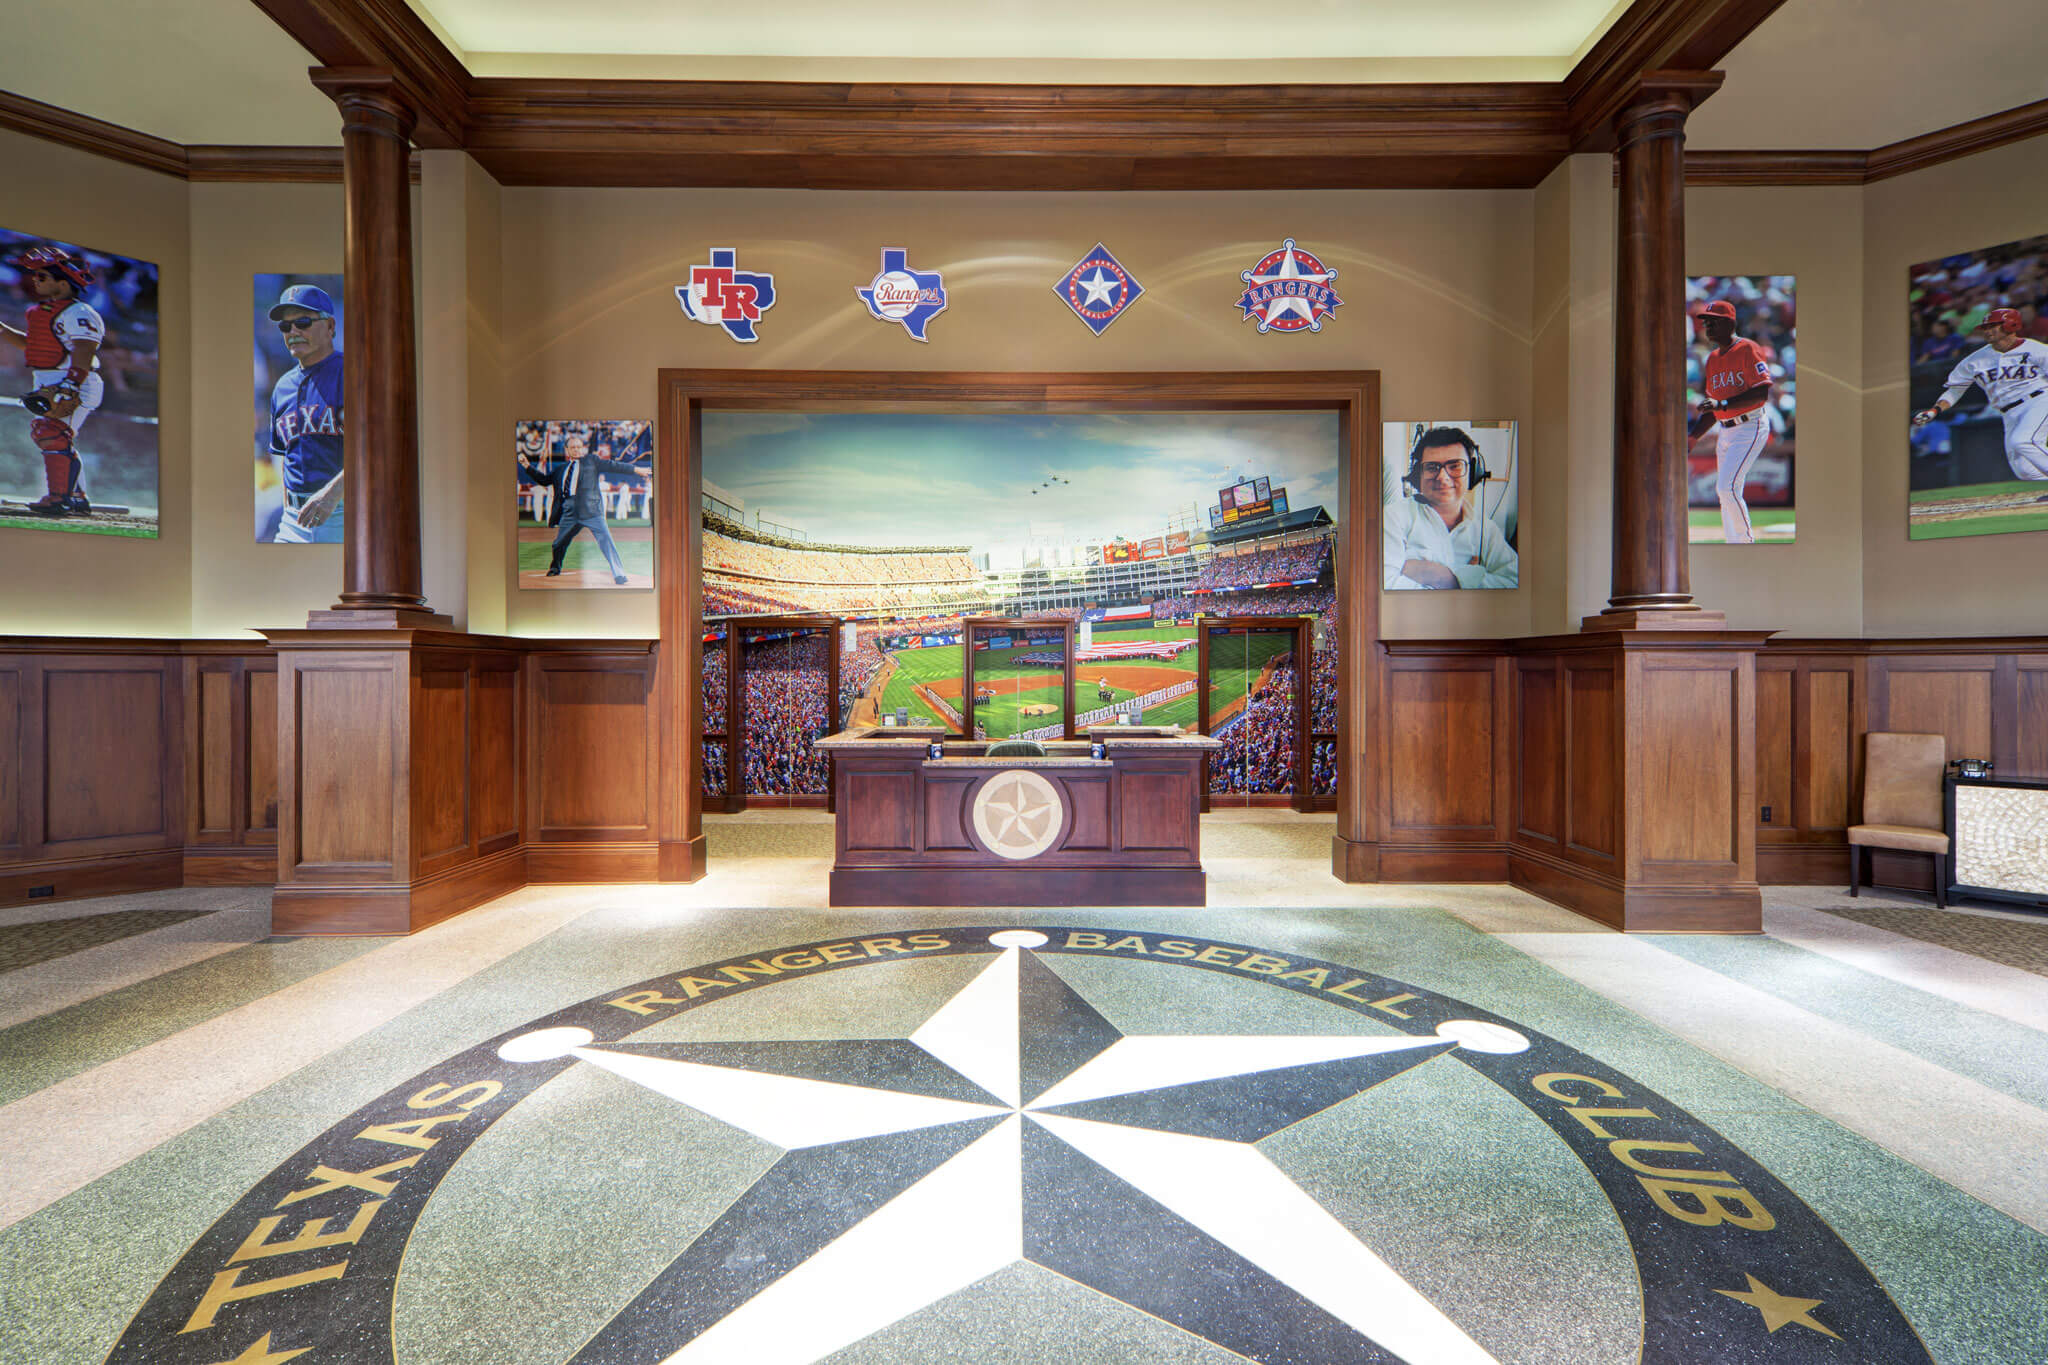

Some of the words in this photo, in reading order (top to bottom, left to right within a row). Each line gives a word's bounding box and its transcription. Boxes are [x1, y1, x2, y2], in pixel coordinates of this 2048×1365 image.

[875, 282, 942, 309] Rangers
[1248, 282, 1329, 304] RANGERS
[1711, 371, 1745, 391] EXAS
[1974, 365, 2038, 387] TEXAS
[176, 1080, 503, 1335] TEXAS
[606, 934, 950, 1016] RANGERS
[1064, 932, 1421, 1020] BASEBALL
[1532, 1072, 1776, 1231] CLUB
